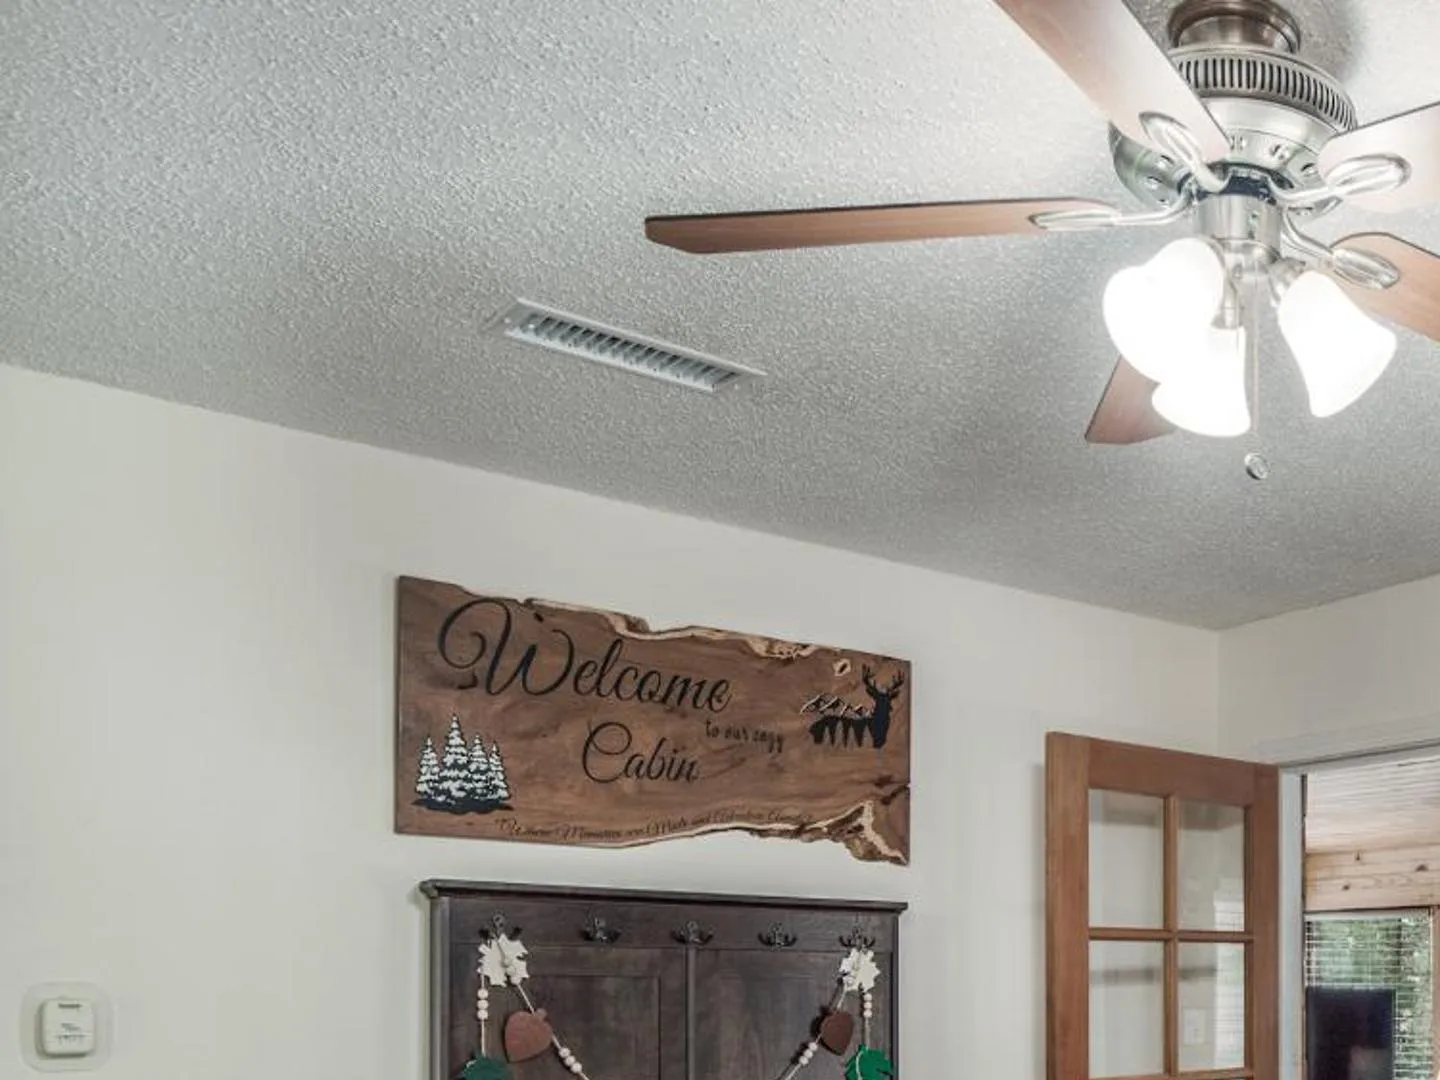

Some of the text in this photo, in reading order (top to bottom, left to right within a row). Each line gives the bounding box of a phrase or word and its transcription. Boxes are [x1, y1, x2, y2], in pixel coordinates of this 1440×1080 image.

[438, 597, 733, 713] Welcome
[581, 721, 699, 784] Cabin
[705, 719, 720, 738] to
[724, 726, 749, 741] our
